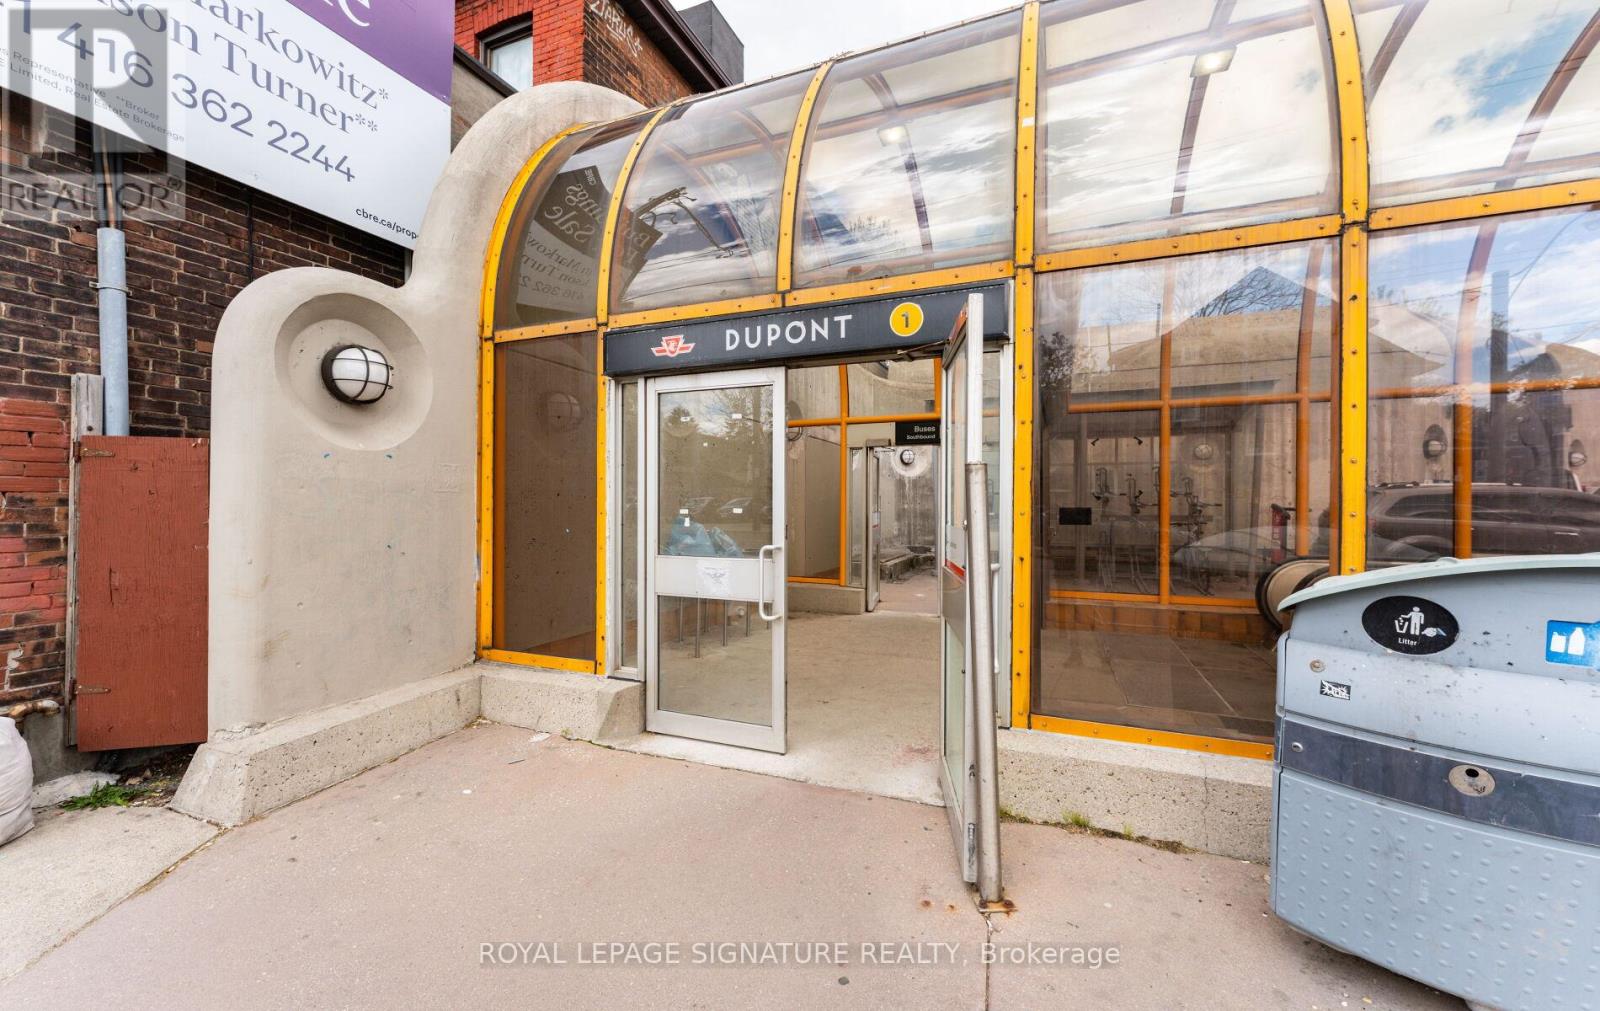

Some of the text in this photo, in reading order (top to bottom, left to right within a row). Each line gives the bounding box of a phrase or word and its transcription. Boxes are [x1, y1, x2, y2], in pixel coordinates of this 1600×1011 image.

[97, 0, 201, 55] son
[192, 0, 389, 110] arkowitz
[57, 22, 154, 88] 416
[171, 73, 254, 138] 362
[267, 120, 356, 182] 2244
[65, 86, 91, 105] Real
[94, 98, 130, 120] Estate
[132, 114, 185, 142] Brokerage
[355, 208, 419, 240] cbre.ca/prop
[724, 314, 853, 352] DUPONT
[901, 312, 911, 329] 1
[914, 425, 936, 433] Buses
[1398, 637, 1417, 646] Litter
